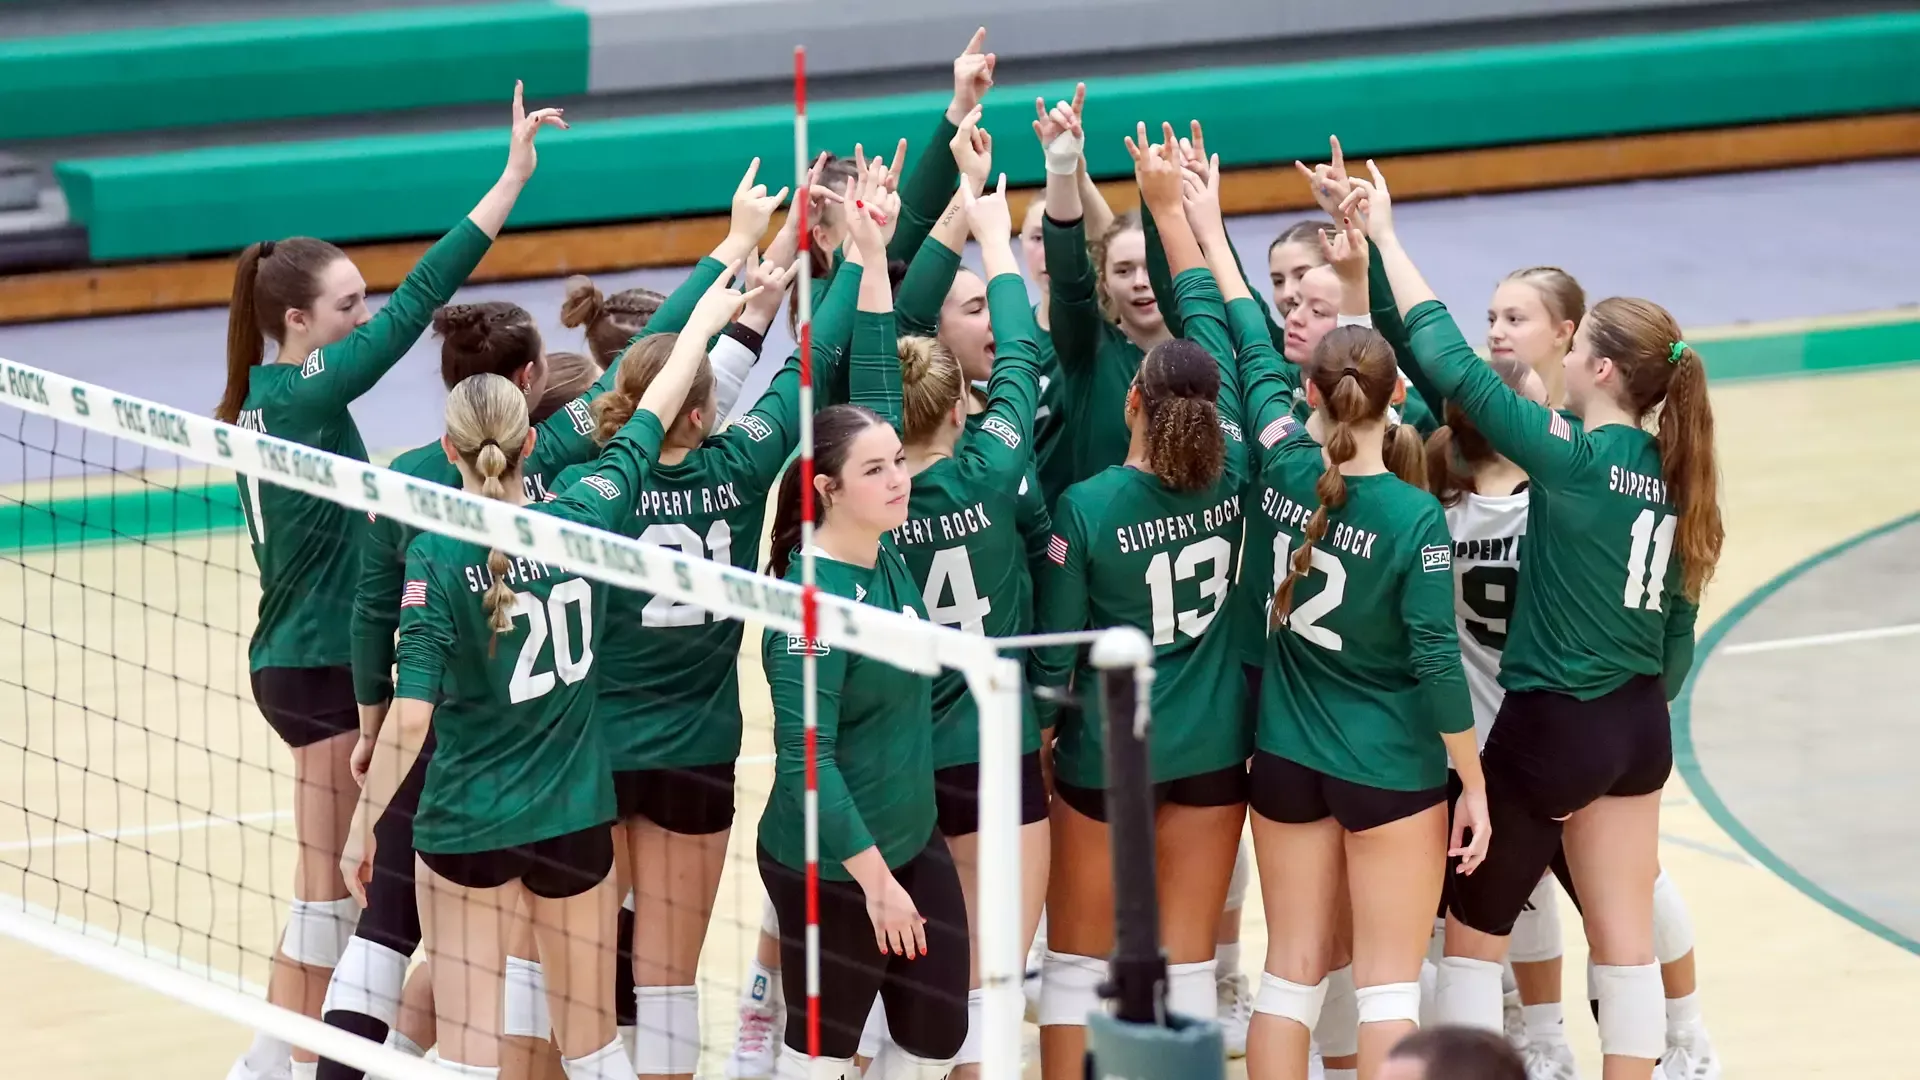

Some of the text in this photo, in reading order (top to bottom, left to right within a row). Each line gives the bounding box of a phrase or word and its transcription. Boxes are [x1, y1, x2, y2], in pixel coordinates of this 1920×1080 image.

[8, 366, 49, 406] ROCK
[71, 386, 90, 416] S
[113, 397, 146, 433] THE
[148, 408, 191, 447] ROCK
[214, 427, 233, 458] S
[256, 439, 290, 475] THE
[292, 449, 338, 488] ROCK
[362, 470, 379, 501] S
[515, 515, 534, 546] S
[674, 560, 692, 591] S
[523, 473, 548, 500] CK
[636, 490, 692, 516] PPERY
[1609, 465, 1668, 505] SLIPPERY
[892, 502, 991, 545] PERY ROCK
[1117, 494, 1241, 553] SLIPPERY ROCK
[1261, 487, 1377, 559] SLIPPE ROCK
[1623, 508, 1678, 613] 11
[637, 519, 732, 628] 21
[1145, 535, 1231, 646] 13
[1266, 531, 1347, 651] 12
[1462, 565, 1518, 653] 9
[503, 577, 594, 704] 20
